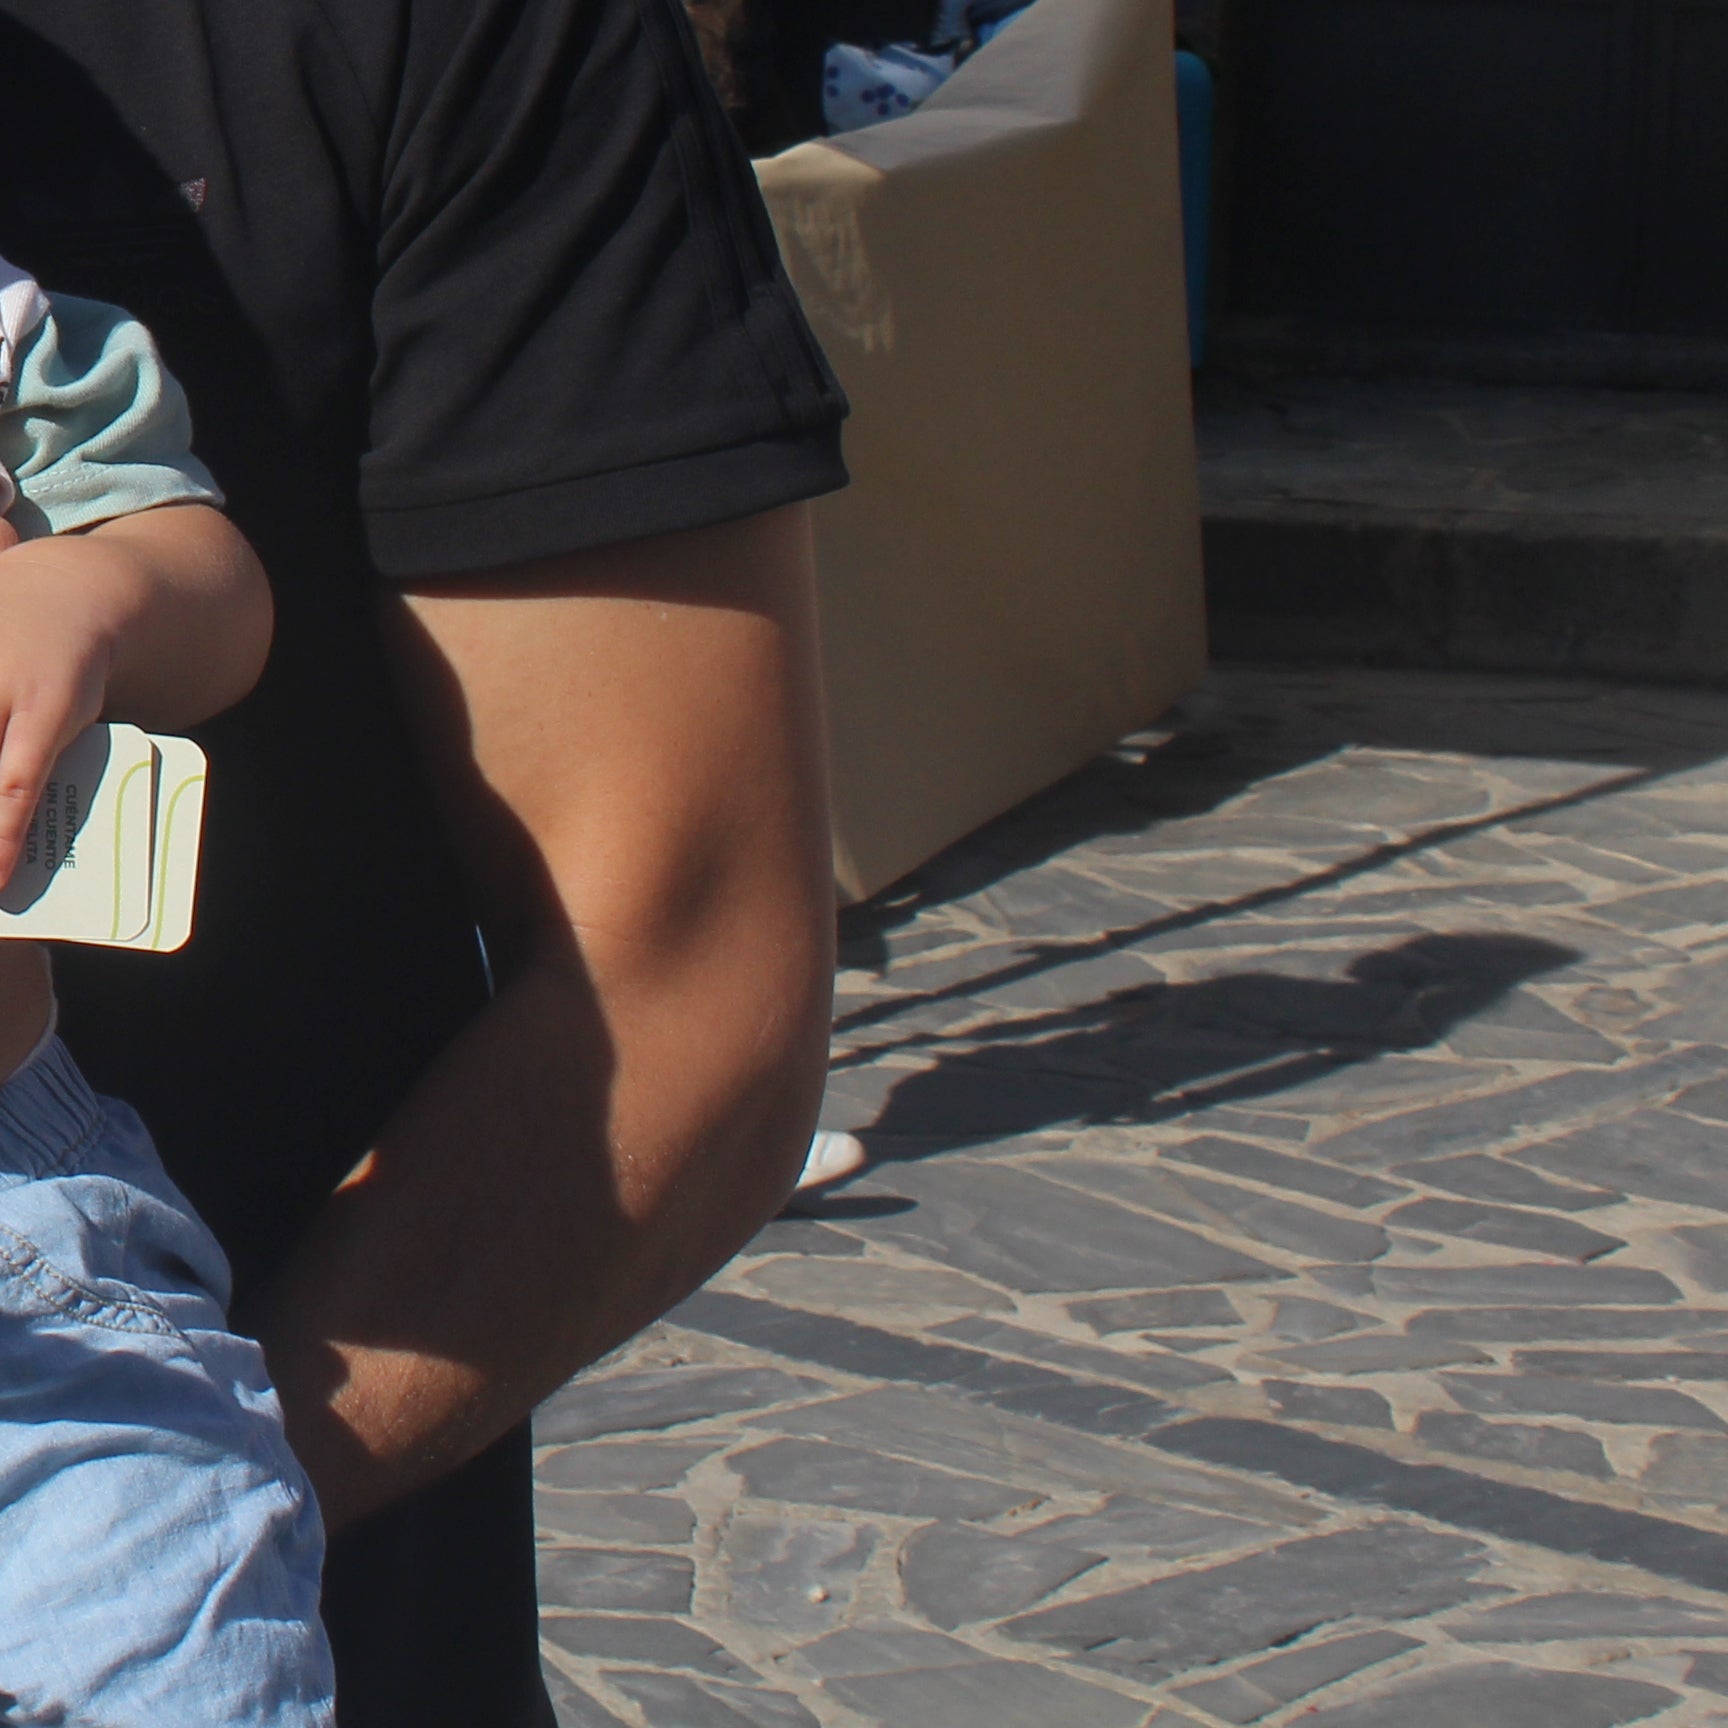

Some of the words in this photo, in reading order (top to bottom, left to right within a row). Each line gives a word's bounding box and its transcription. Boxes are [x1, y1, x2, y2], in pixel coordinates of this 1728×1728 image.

[45, 782, 58, 804] UN
[44, 808, 58, 870] CUENTO
[63, 784, 77, 869] CUÉNTAME
